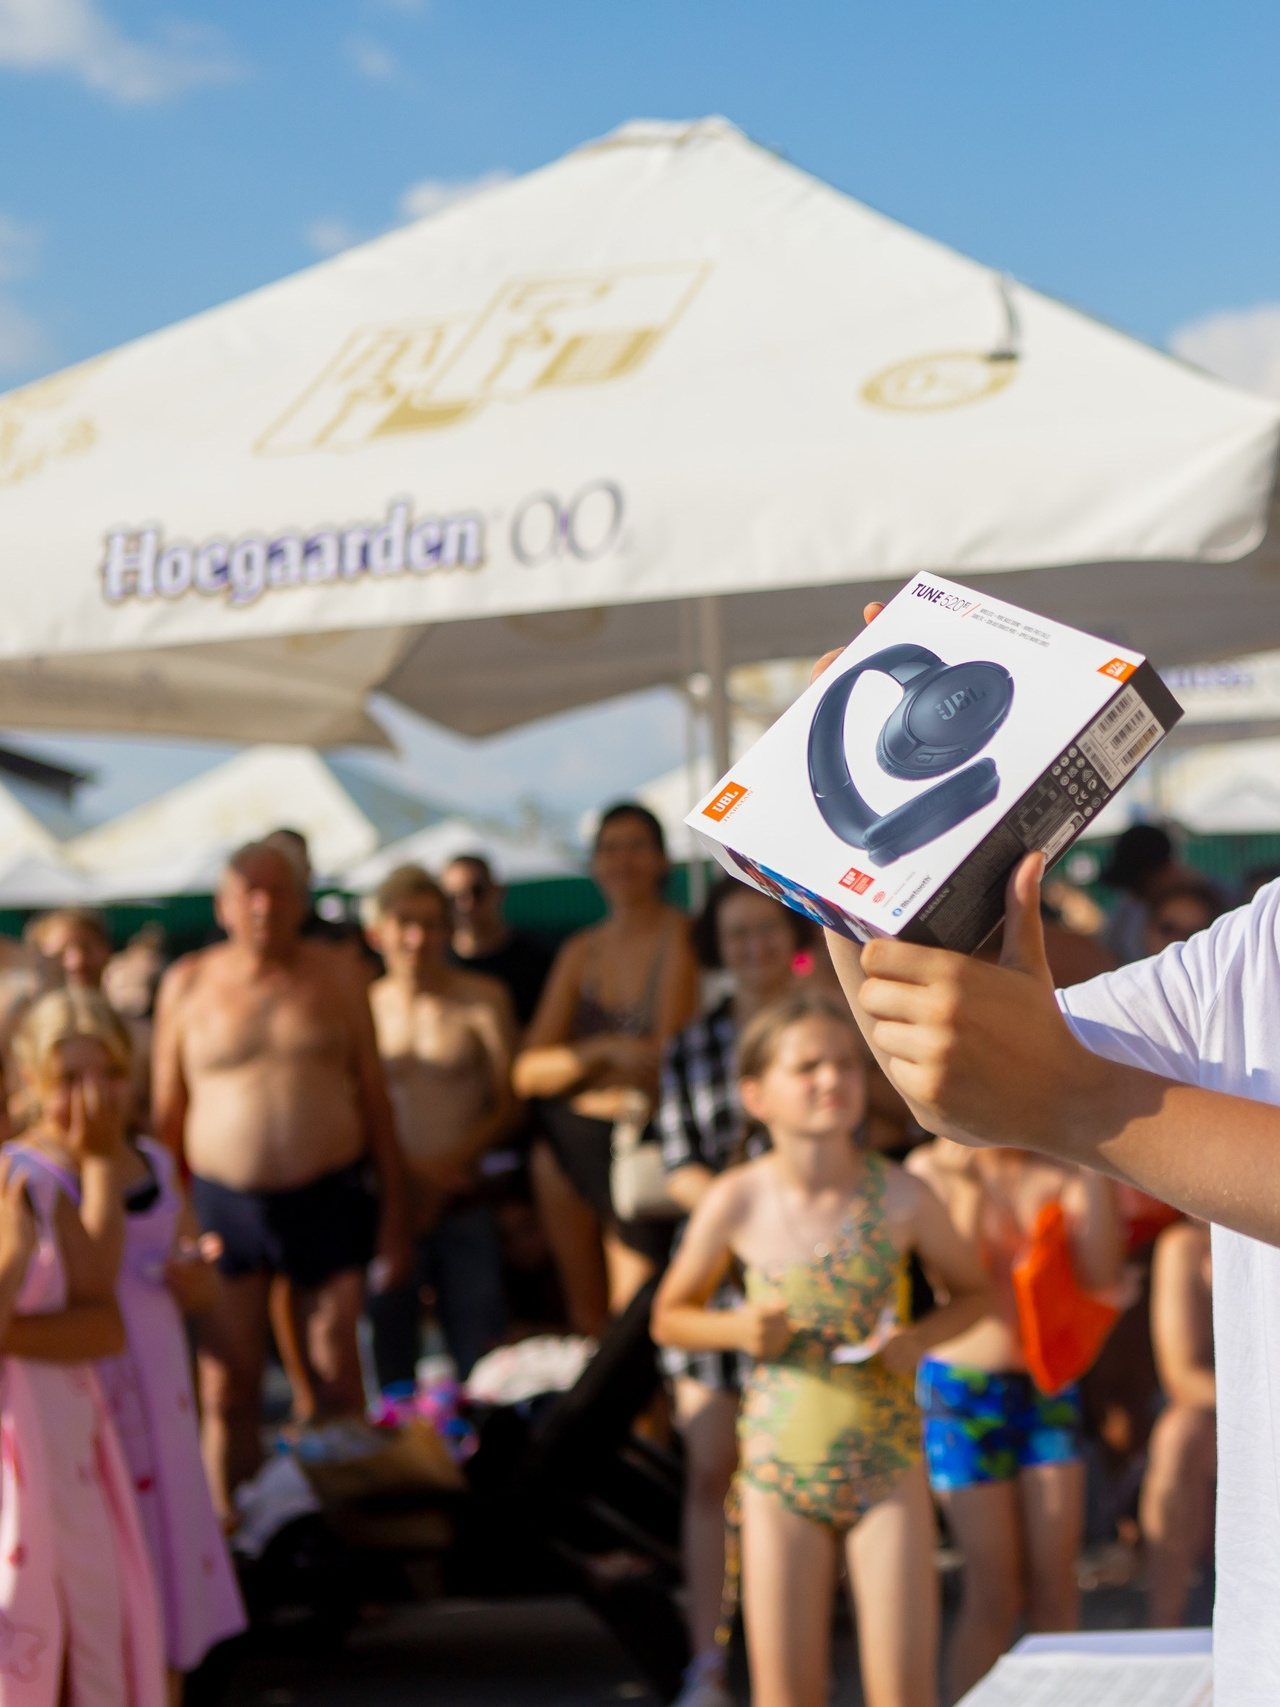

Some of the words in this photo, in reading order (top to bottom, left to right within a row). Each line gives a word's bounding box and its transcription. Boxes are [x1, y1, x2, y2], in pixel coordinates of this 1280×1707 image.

[101, 495, 486, 604] Hoegaarden
[911, 583, 945, 603] TUNE
[935, 687, 987, 720] JBL
[711, 791, 739, 813] JBL
